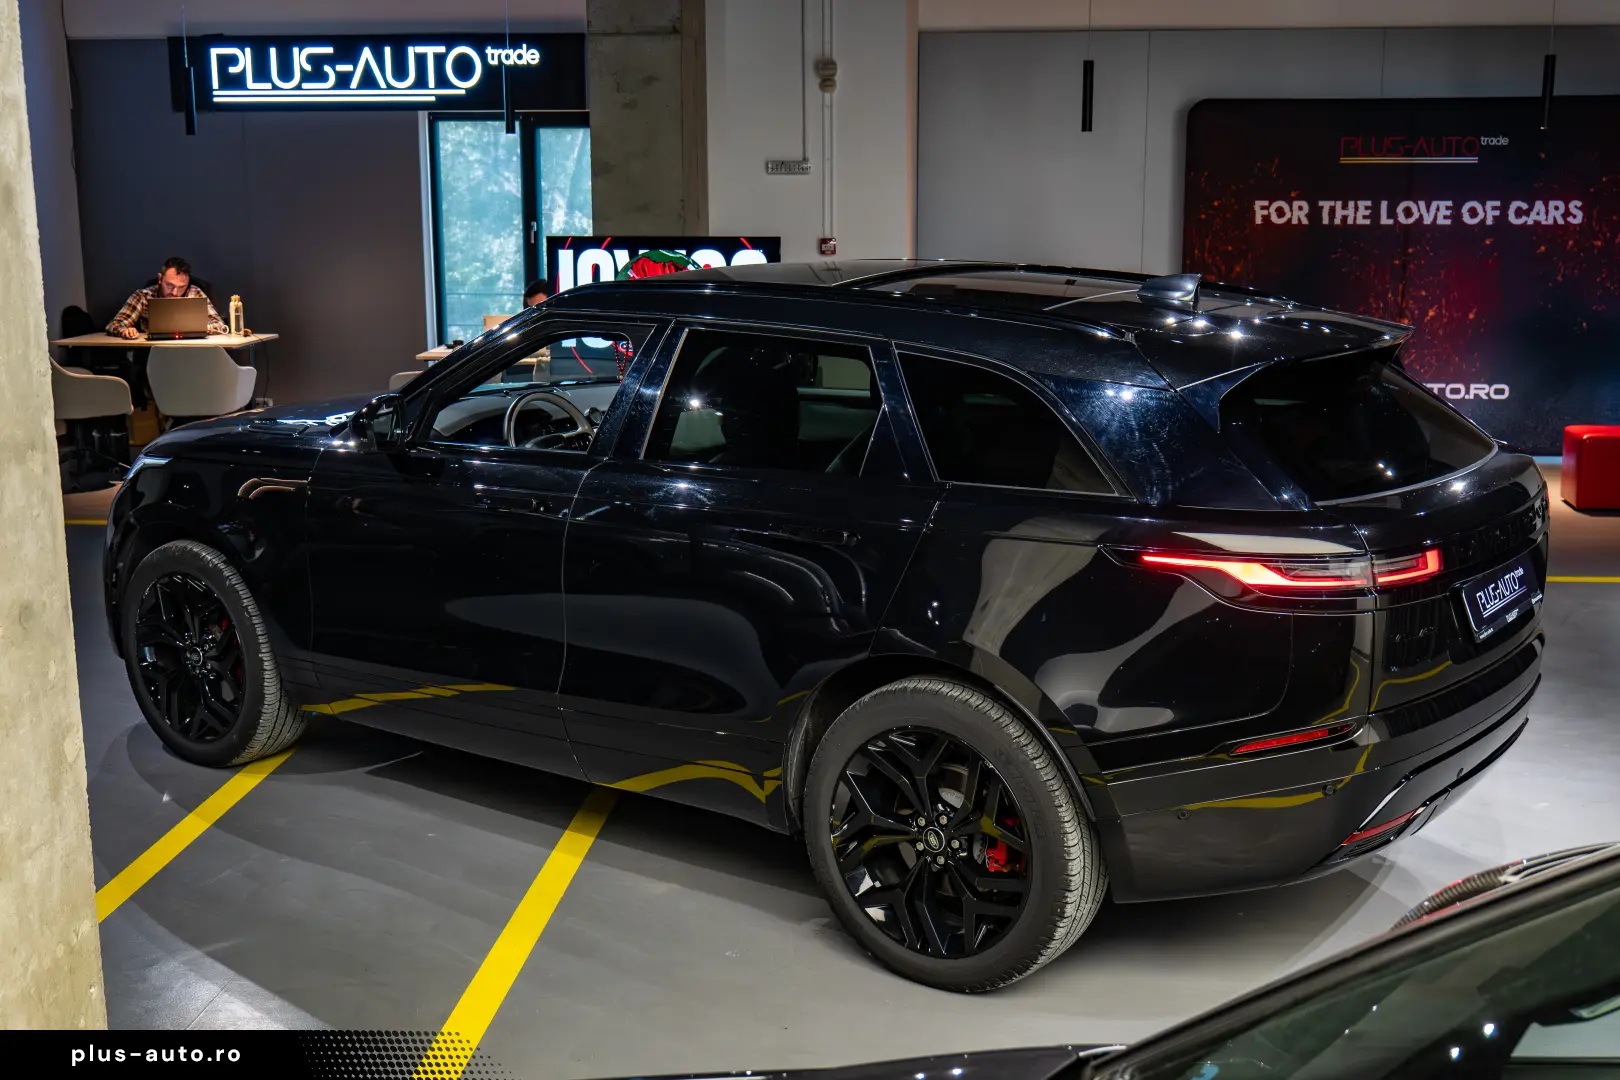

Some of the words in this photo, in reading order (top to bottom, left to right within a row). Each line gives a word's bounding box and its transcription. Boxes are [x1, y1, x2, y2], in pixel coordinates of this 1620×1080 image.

[210, 46, 482, 89] PLUS-AUTO
[485, 44, 541, 65] trade
[1340, 136, 1479, 157] PLUS-AUTO
[1480, 135, 1509, 146] trade
[1253, 200, 1309, 225] FOR
[1318, 200, 1372, 225] THE
[1380, 200, 1453, 225] LOVE
[1461, 200, 1500, 225] OF
[1507, 200, 1583, 225] CARS
[1423, 383, 1510, 400] TO.RO
